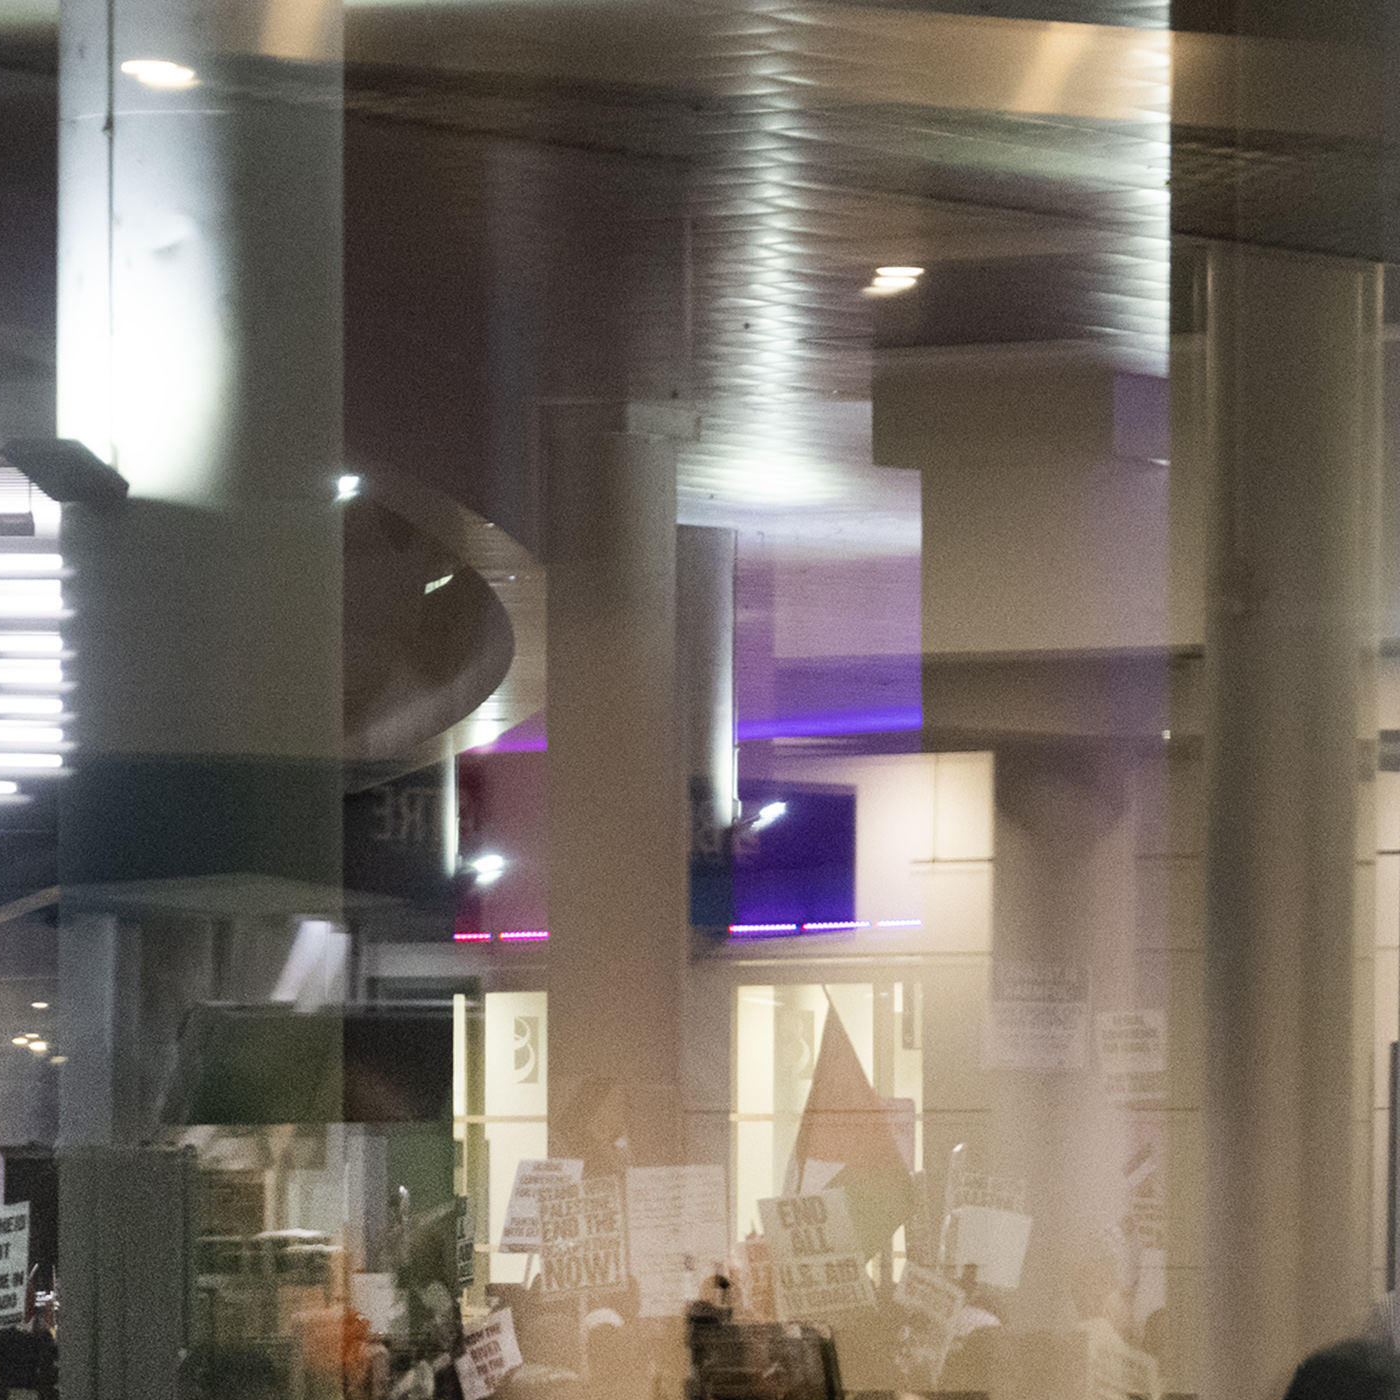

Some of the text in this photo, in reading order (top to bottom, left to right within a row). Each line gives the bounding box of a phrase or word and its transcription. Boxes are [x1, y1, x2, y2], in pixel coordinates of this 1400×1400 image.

[777, 1194, 829, 1229] END
[790, 1225, 835, 1258] ALL
[778, 1262, 819, 1291] U.S.
